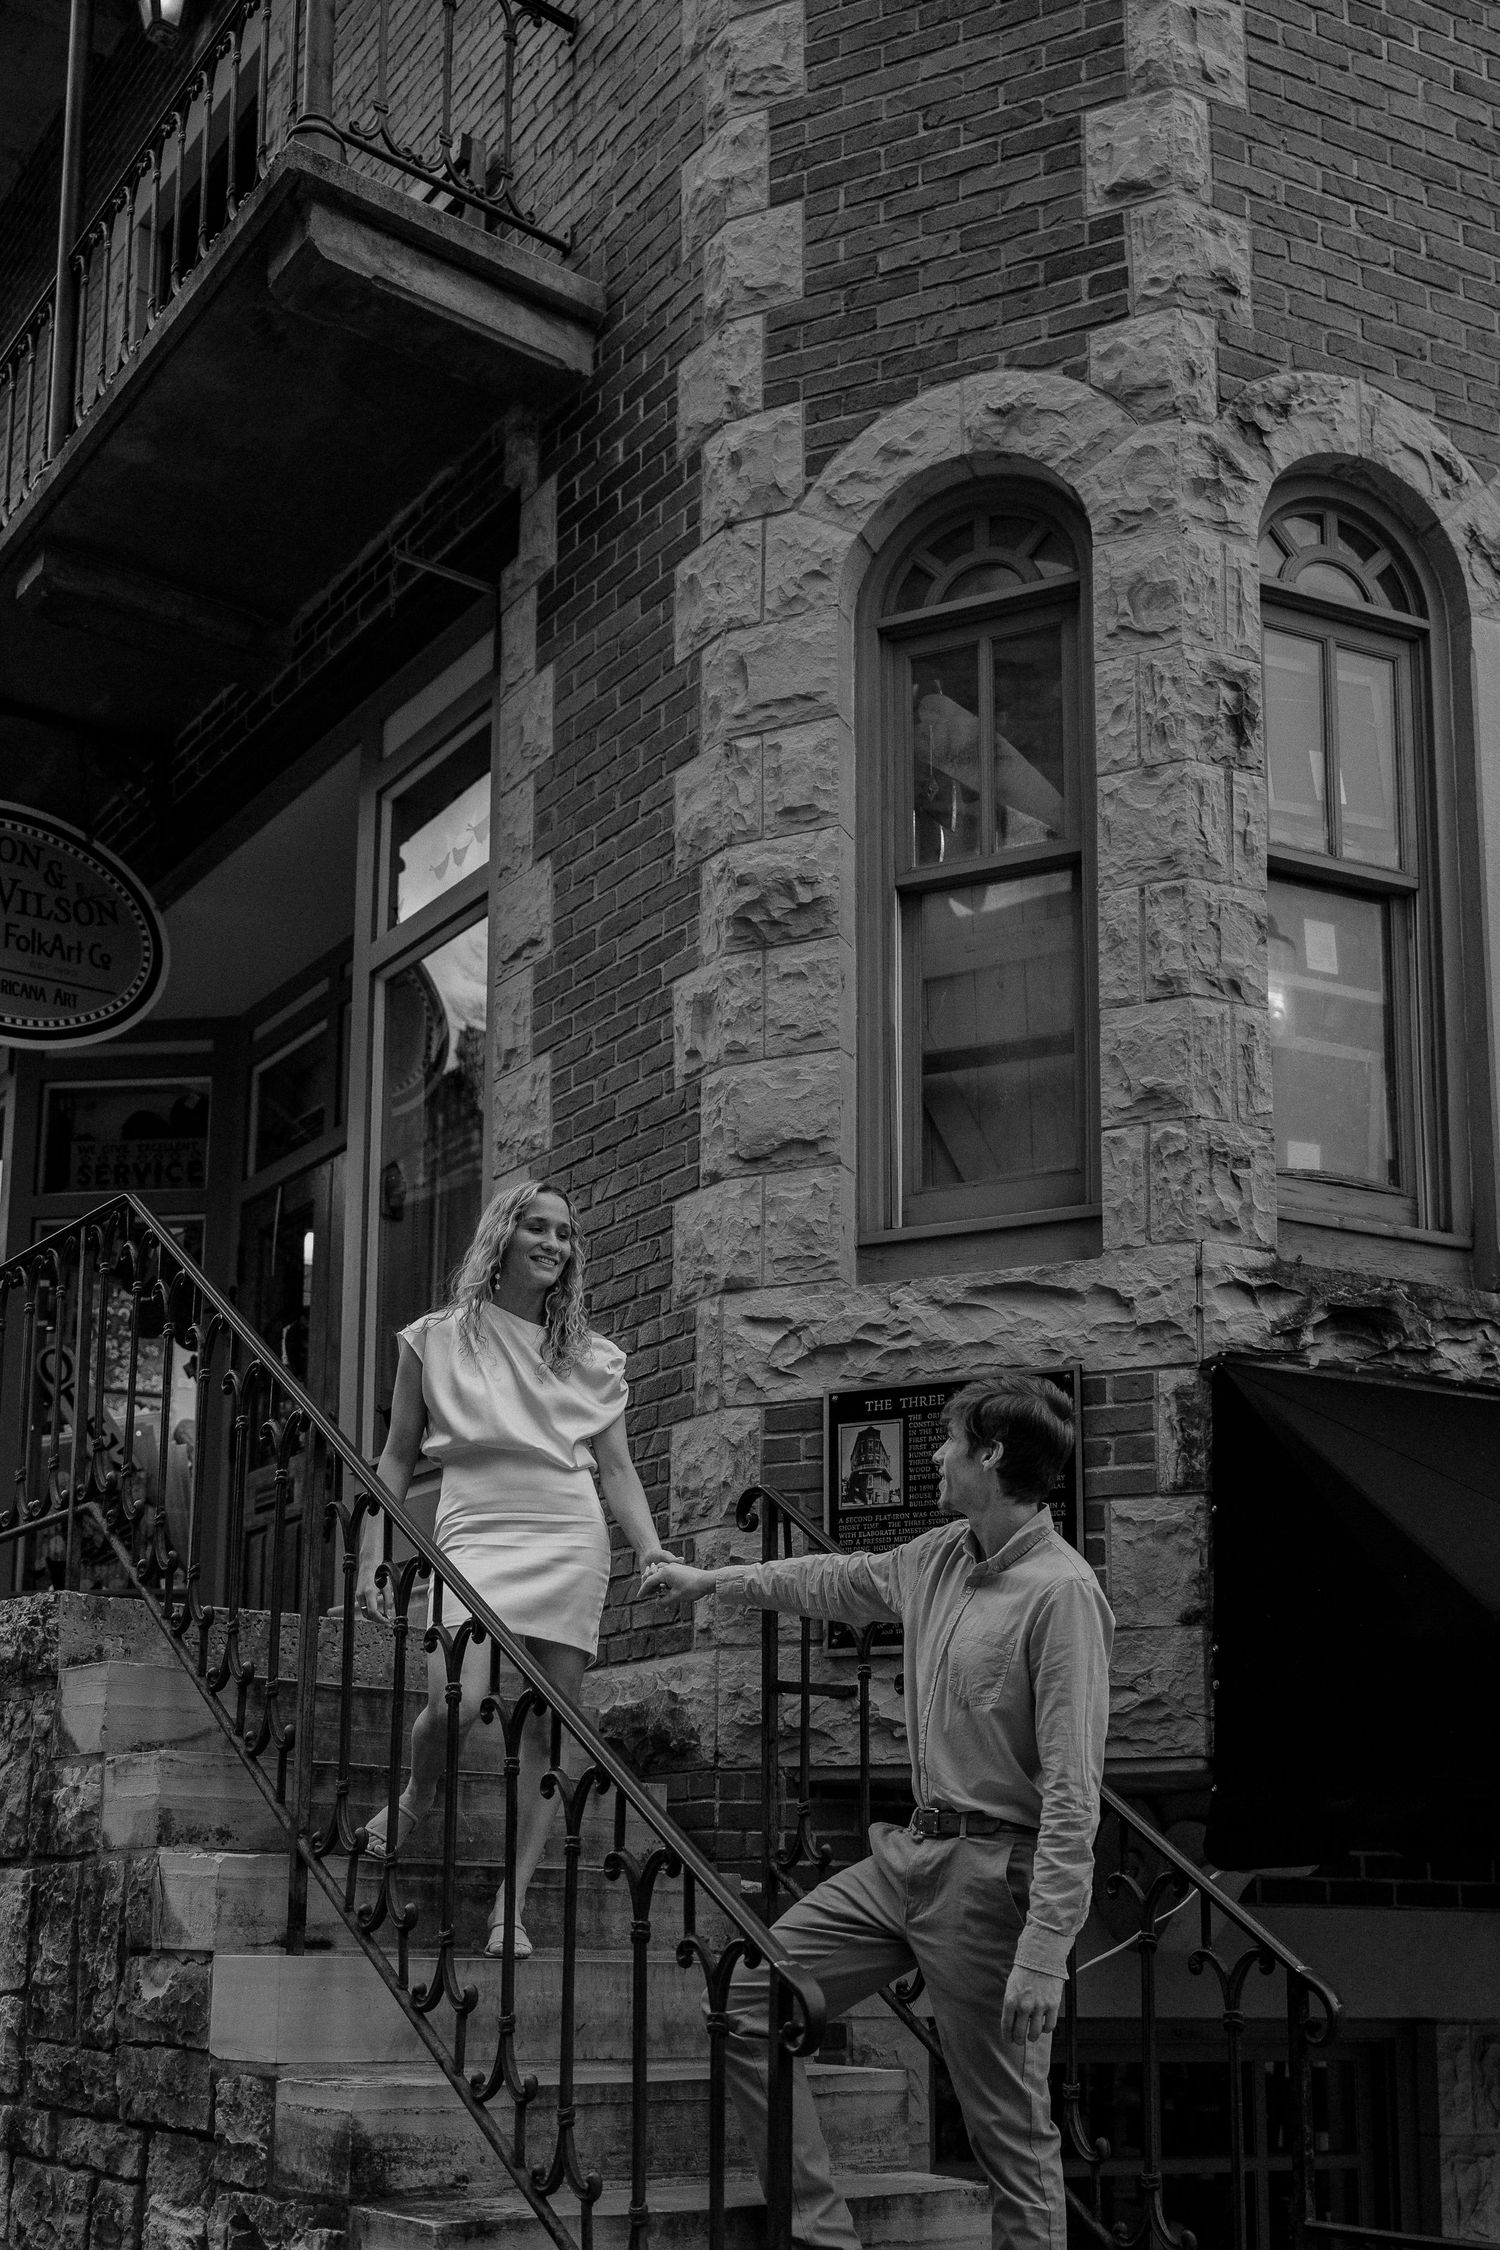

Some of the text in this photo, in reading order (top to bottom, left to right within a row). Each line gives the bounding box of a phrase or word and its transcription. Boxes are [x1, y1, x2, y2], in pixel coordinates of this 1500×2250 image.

[44, 860, 67, 889] &
[53, 988, 78, 1009] ART
[77, 1161, 204, 1186] SERVICE
[865, 1394, 945, 1412] THE THREE
[908, 1413, 922, 1421] THE
[918, 1428, 932, 1436] THE
[908, 1436, 926, 1444] FIRST
[908, 1492, 932, 1500] HOUSE
[908, 1499, 937, 1508] BUILDIN
[846, 1515, 873, 1523] SECOND
[875, 1513, 910, 1521] FLAT-IRON
[838, 1523, 860, 1531] SHORT
[858, 1529, 896, 1538] ELABORATE
[898, 1526, 933, 1535] LIMESTON
[838, 1539, 853, 1547] AND
[862, 1536, 892, 1544] PRESSED
[841, 1545, 871, 1553] UILDING
